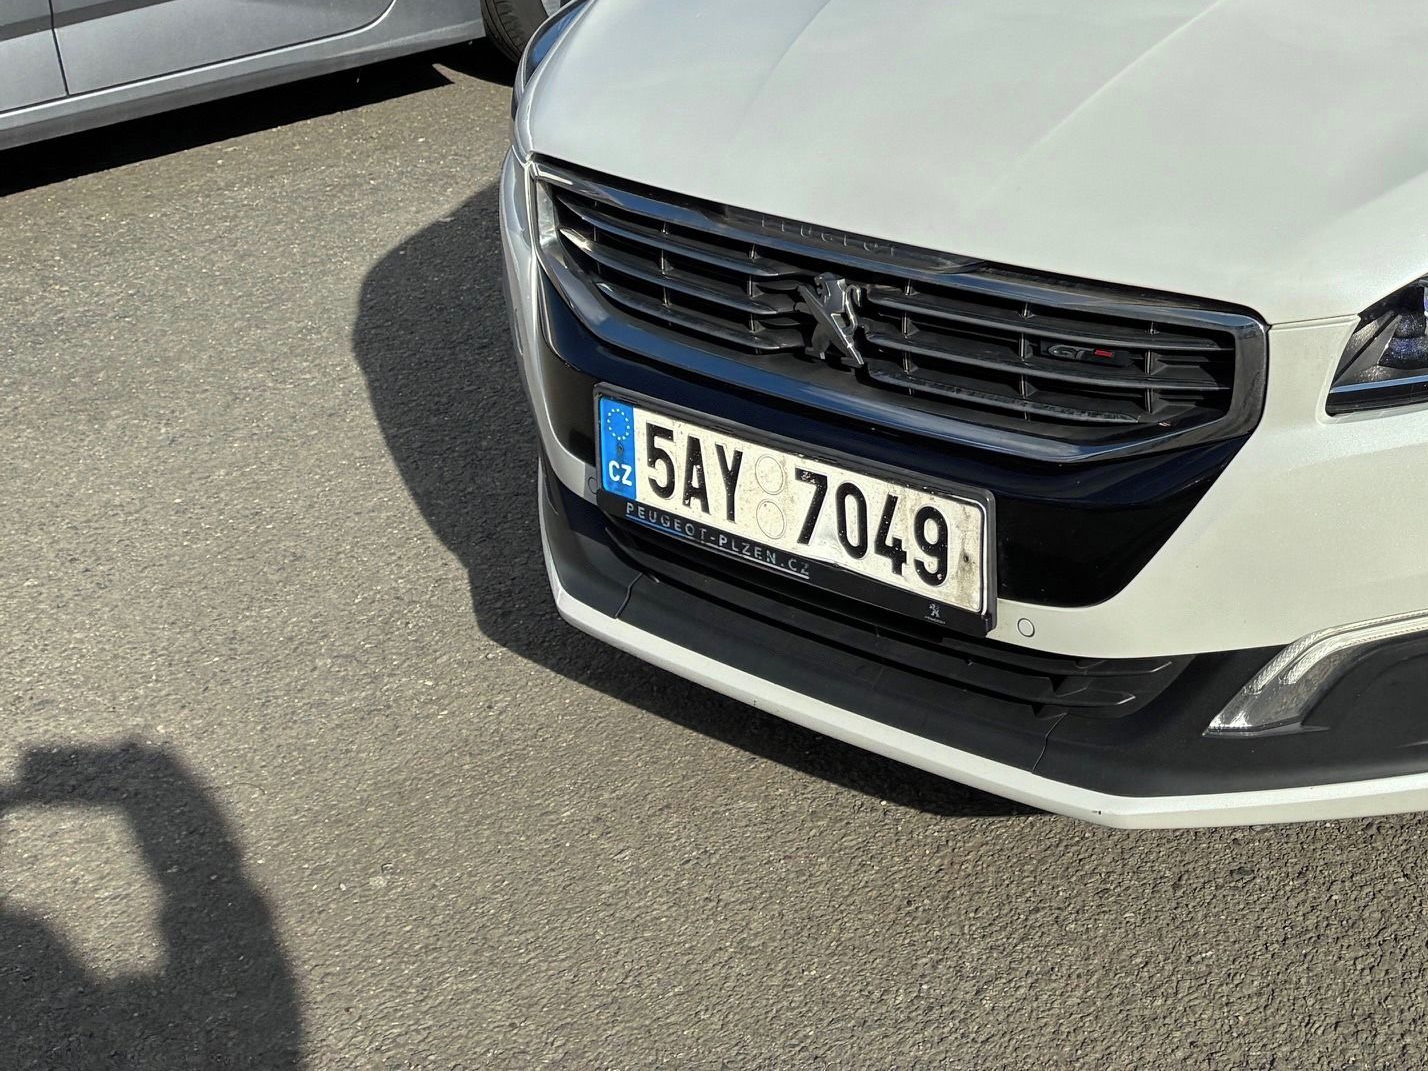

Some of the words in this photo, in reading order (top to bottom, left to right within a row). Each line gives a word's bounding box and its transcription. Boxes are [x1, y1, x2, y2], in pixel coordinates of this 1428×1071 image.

[608, 459, 634, 488] CZ
[644, 420, 744, 525] 5AY
[793, 466, 950, 588] 7049
[625, 501, 811, 575] PEUGEOT-PLZEN.CZ
